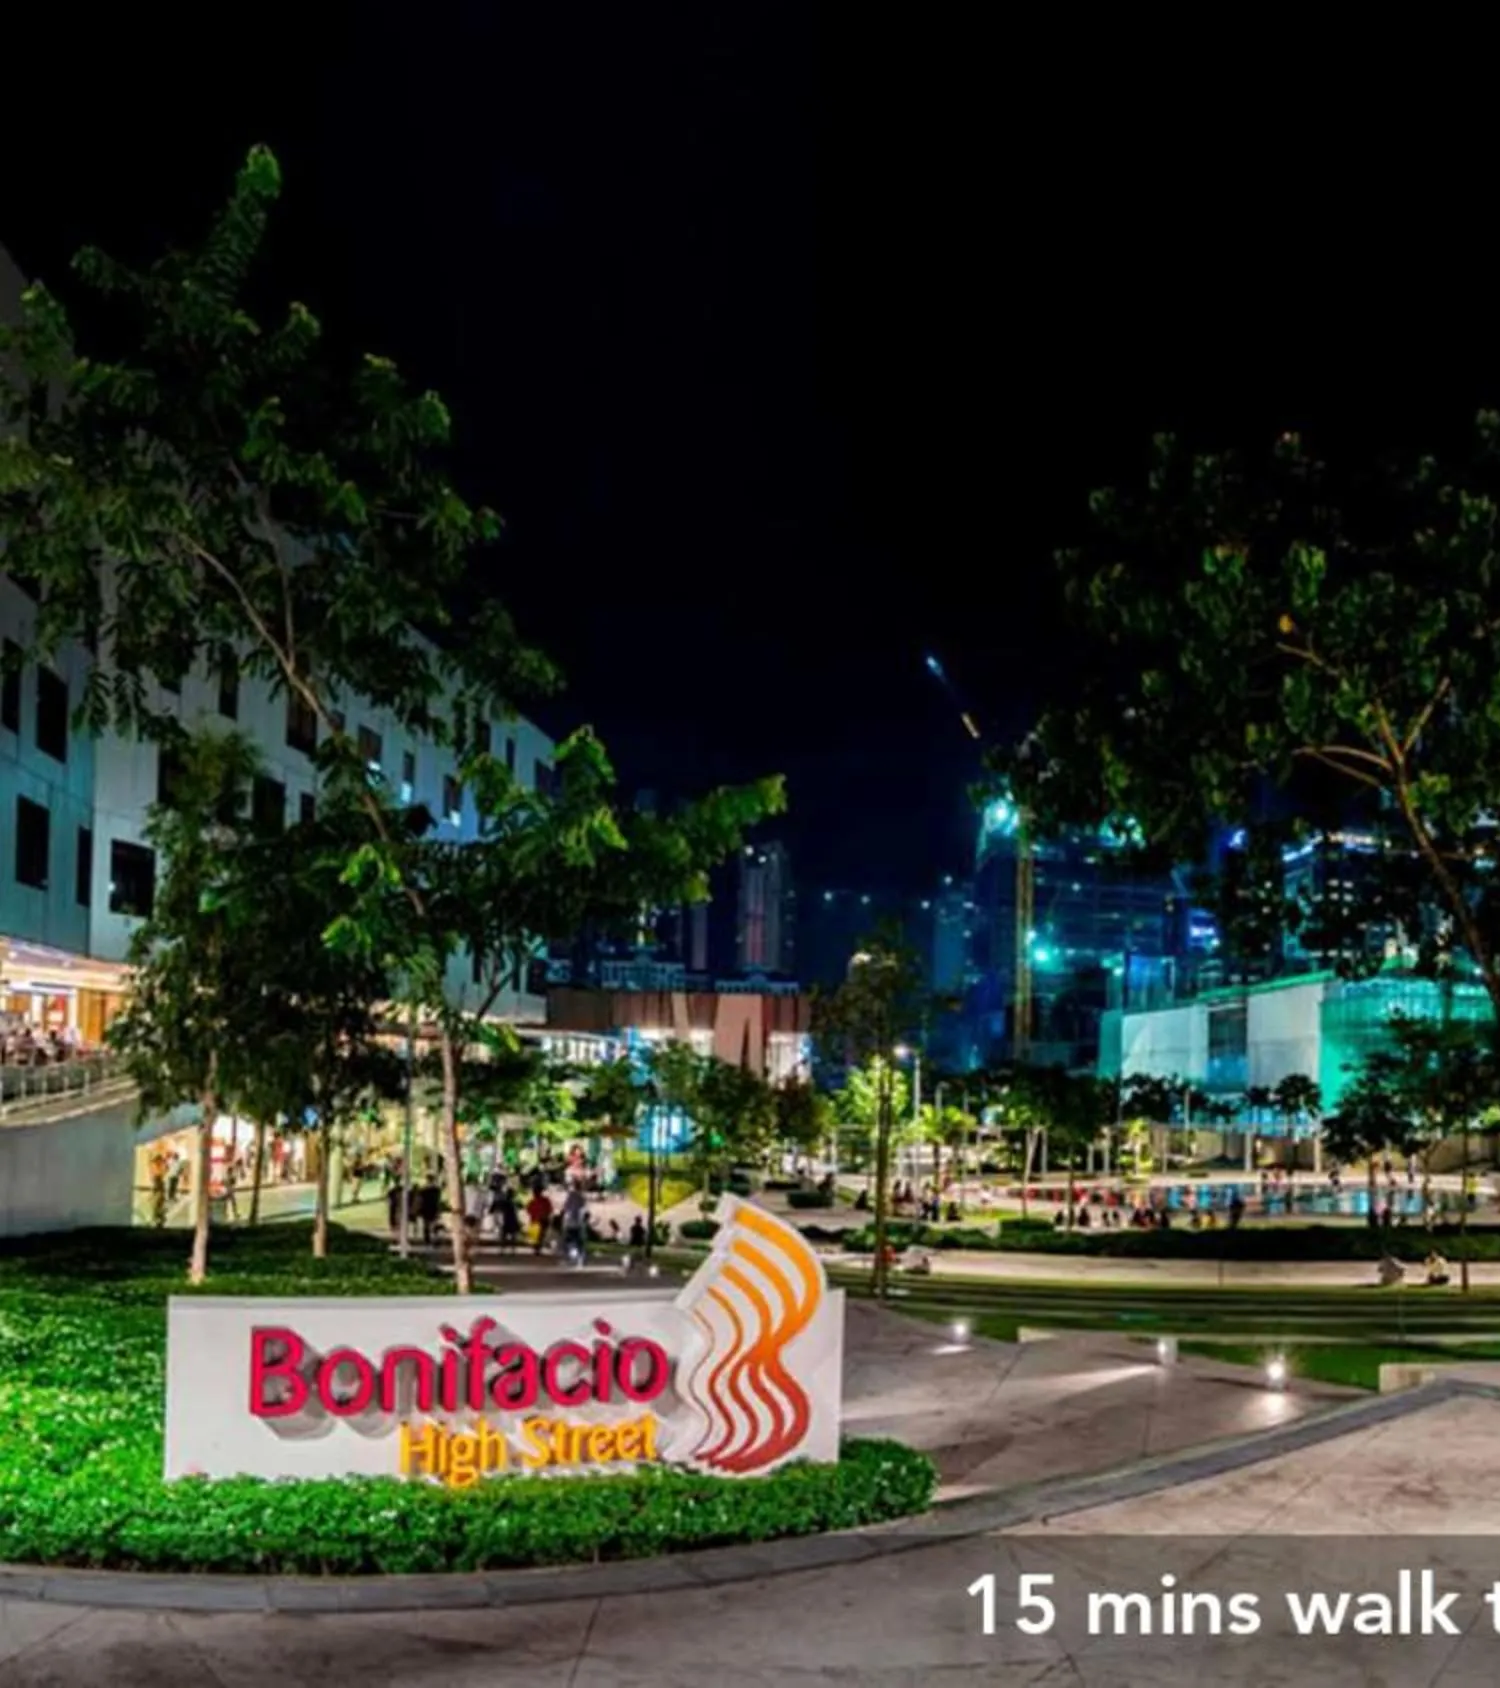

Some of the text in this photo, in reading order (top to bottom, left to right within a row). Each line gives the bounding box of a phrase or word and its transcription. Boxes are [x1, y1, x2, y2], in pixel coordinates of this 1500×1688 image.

[249, 1315, 670, 1418] Bonifacio
[399, 1411, 660, 1488] High Street
